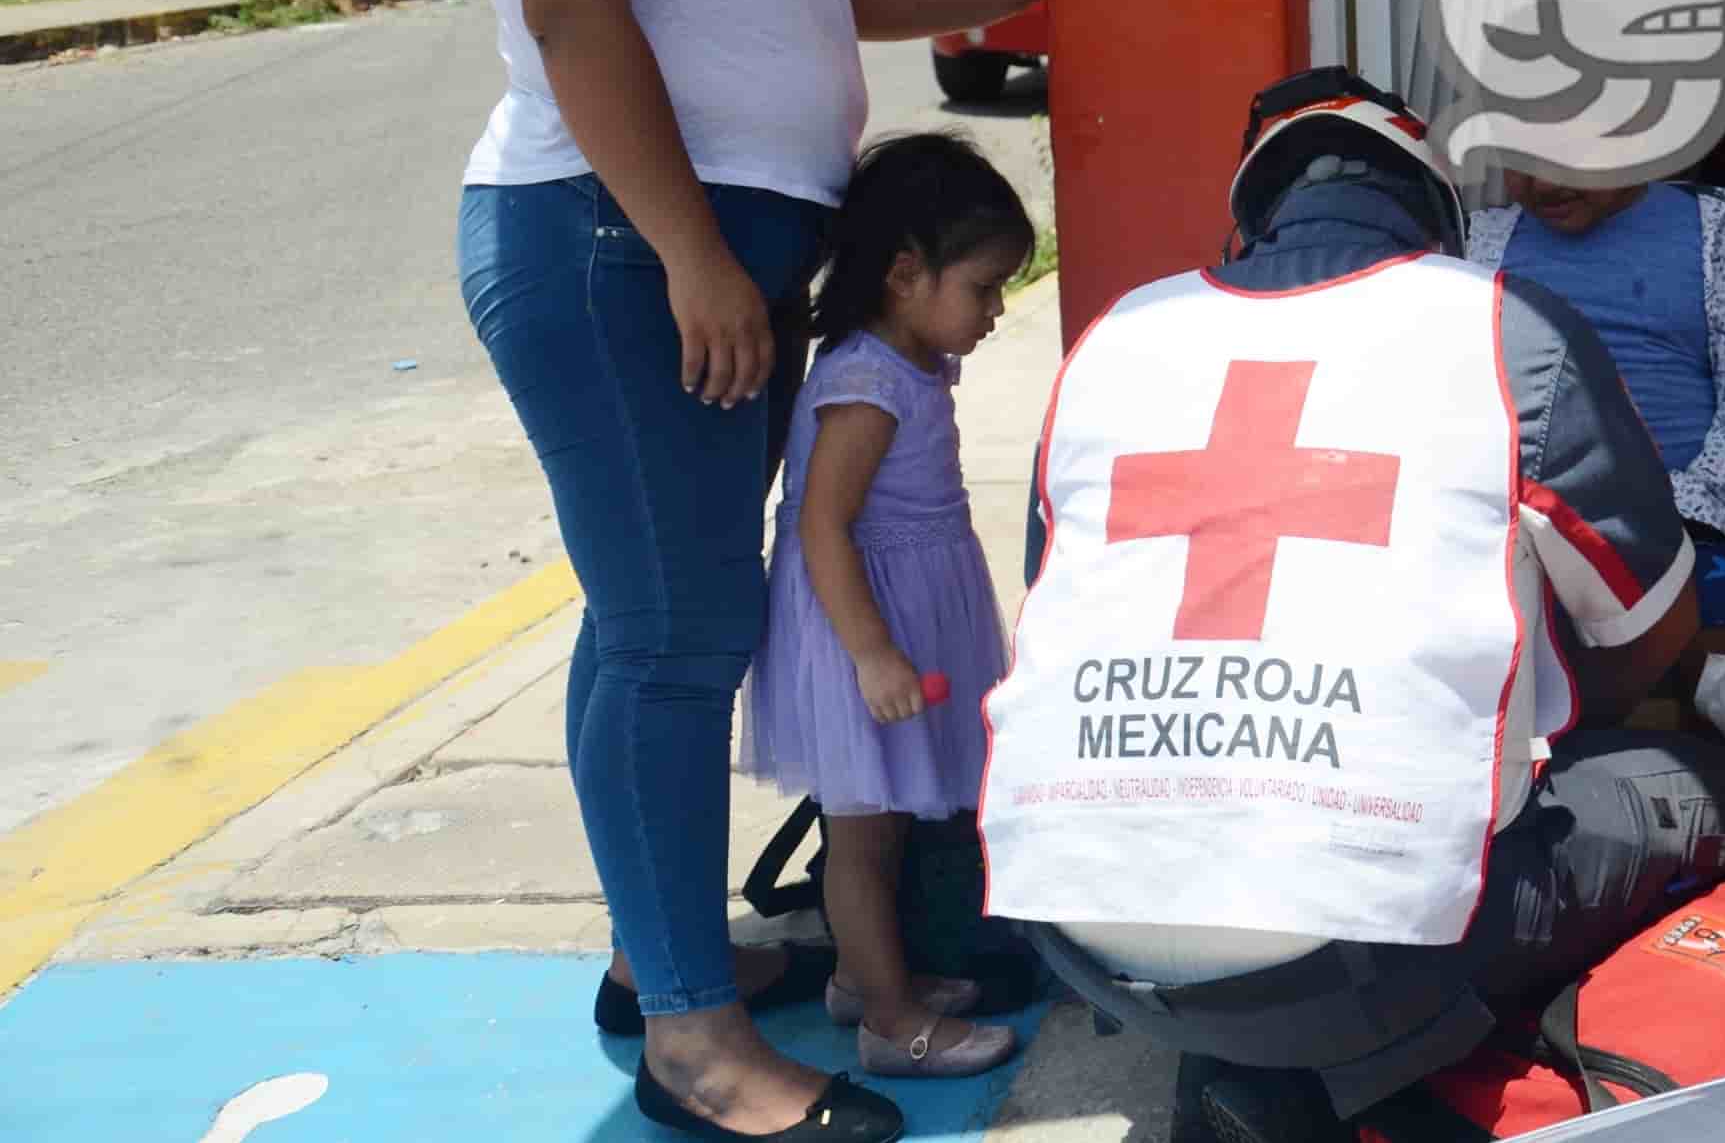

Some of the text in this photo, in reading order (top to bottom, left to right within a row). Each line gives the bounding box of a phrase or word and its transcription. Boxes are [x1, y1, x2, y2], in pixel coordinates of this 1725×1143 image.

[1073, 655, 1362, 714] CRUZ ROJA
[1077, 712, 1341, 768] MEXICANA
